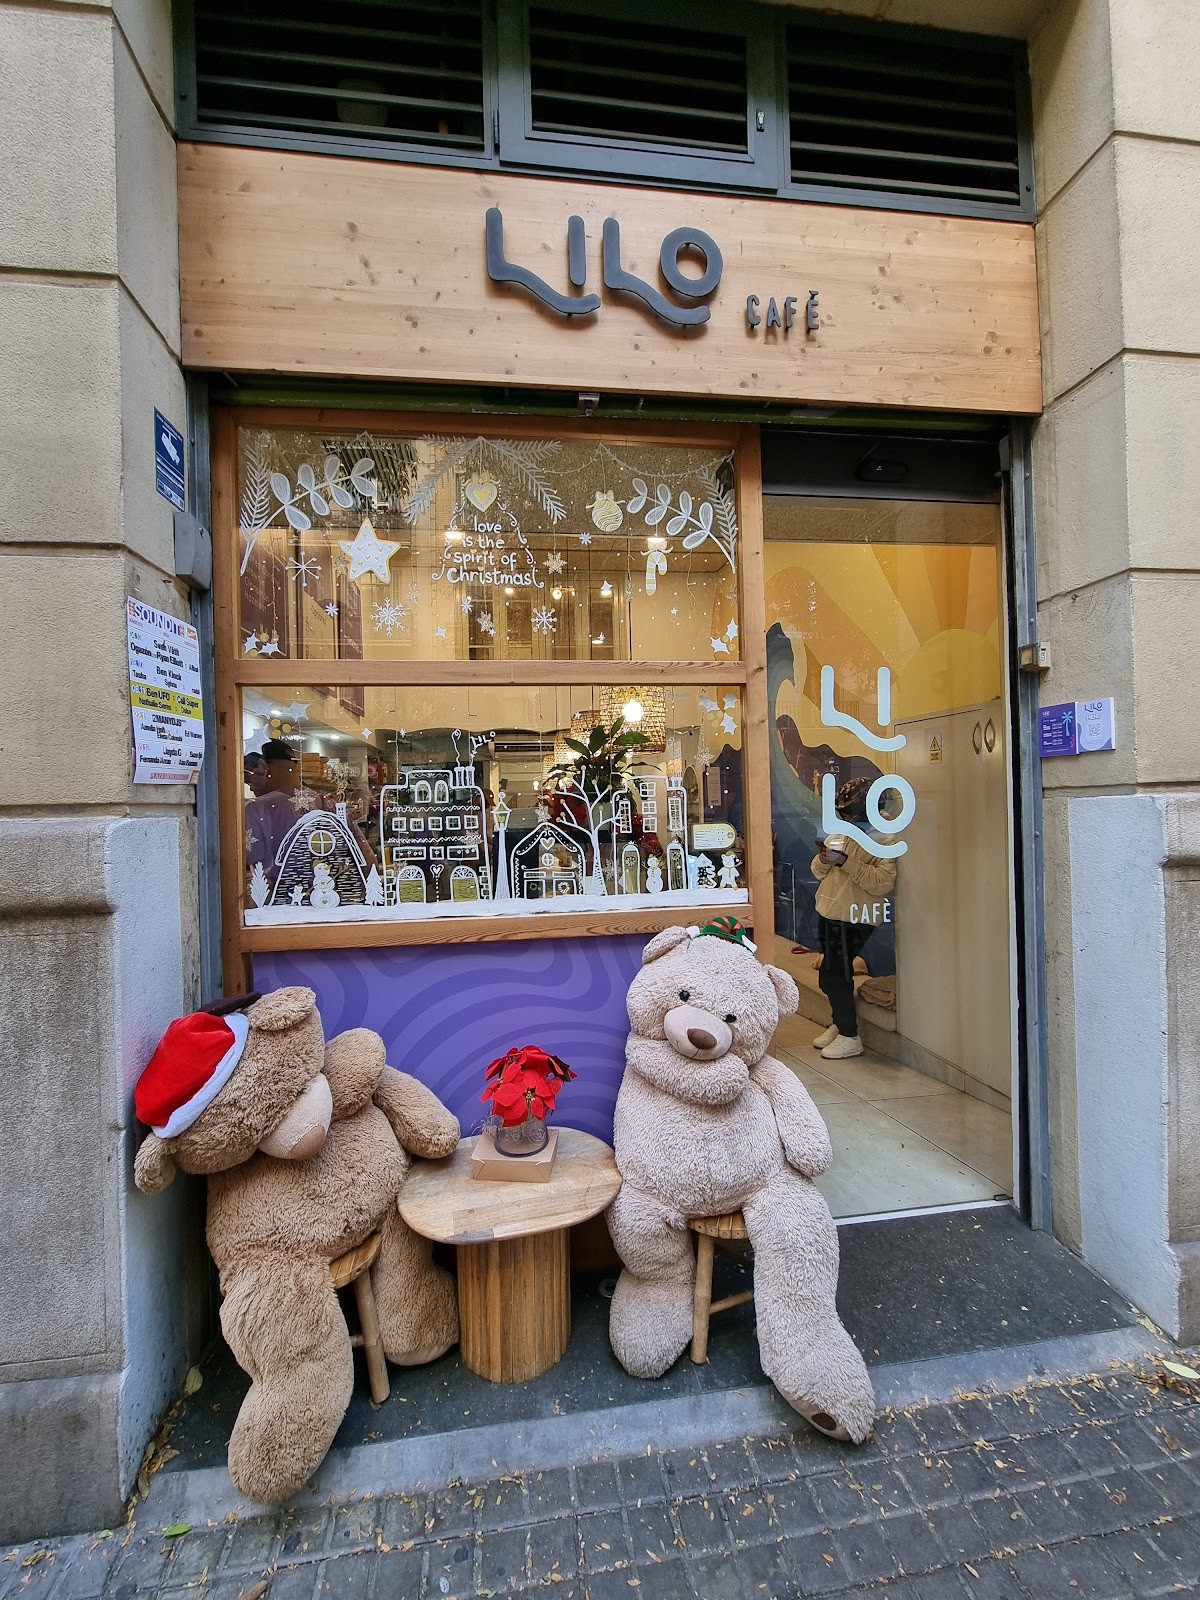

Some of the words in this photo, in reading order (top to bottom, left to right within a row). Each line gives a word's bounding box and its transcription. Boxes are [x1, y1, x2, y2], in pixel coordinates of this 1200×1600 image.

[486, 207, 723, 325] LILO
[474, 515, 502, 534] love
[462, 535, 473, 547] is
[477, 534, 505, 549] the
[453, 549, 495, 570] spirit
[501, 552, 517, 572] of
[446, 565, 532, 586] Christmas
[159, 690, 170, 700] UFO
[1085, 702, 1102, 712] LILO
